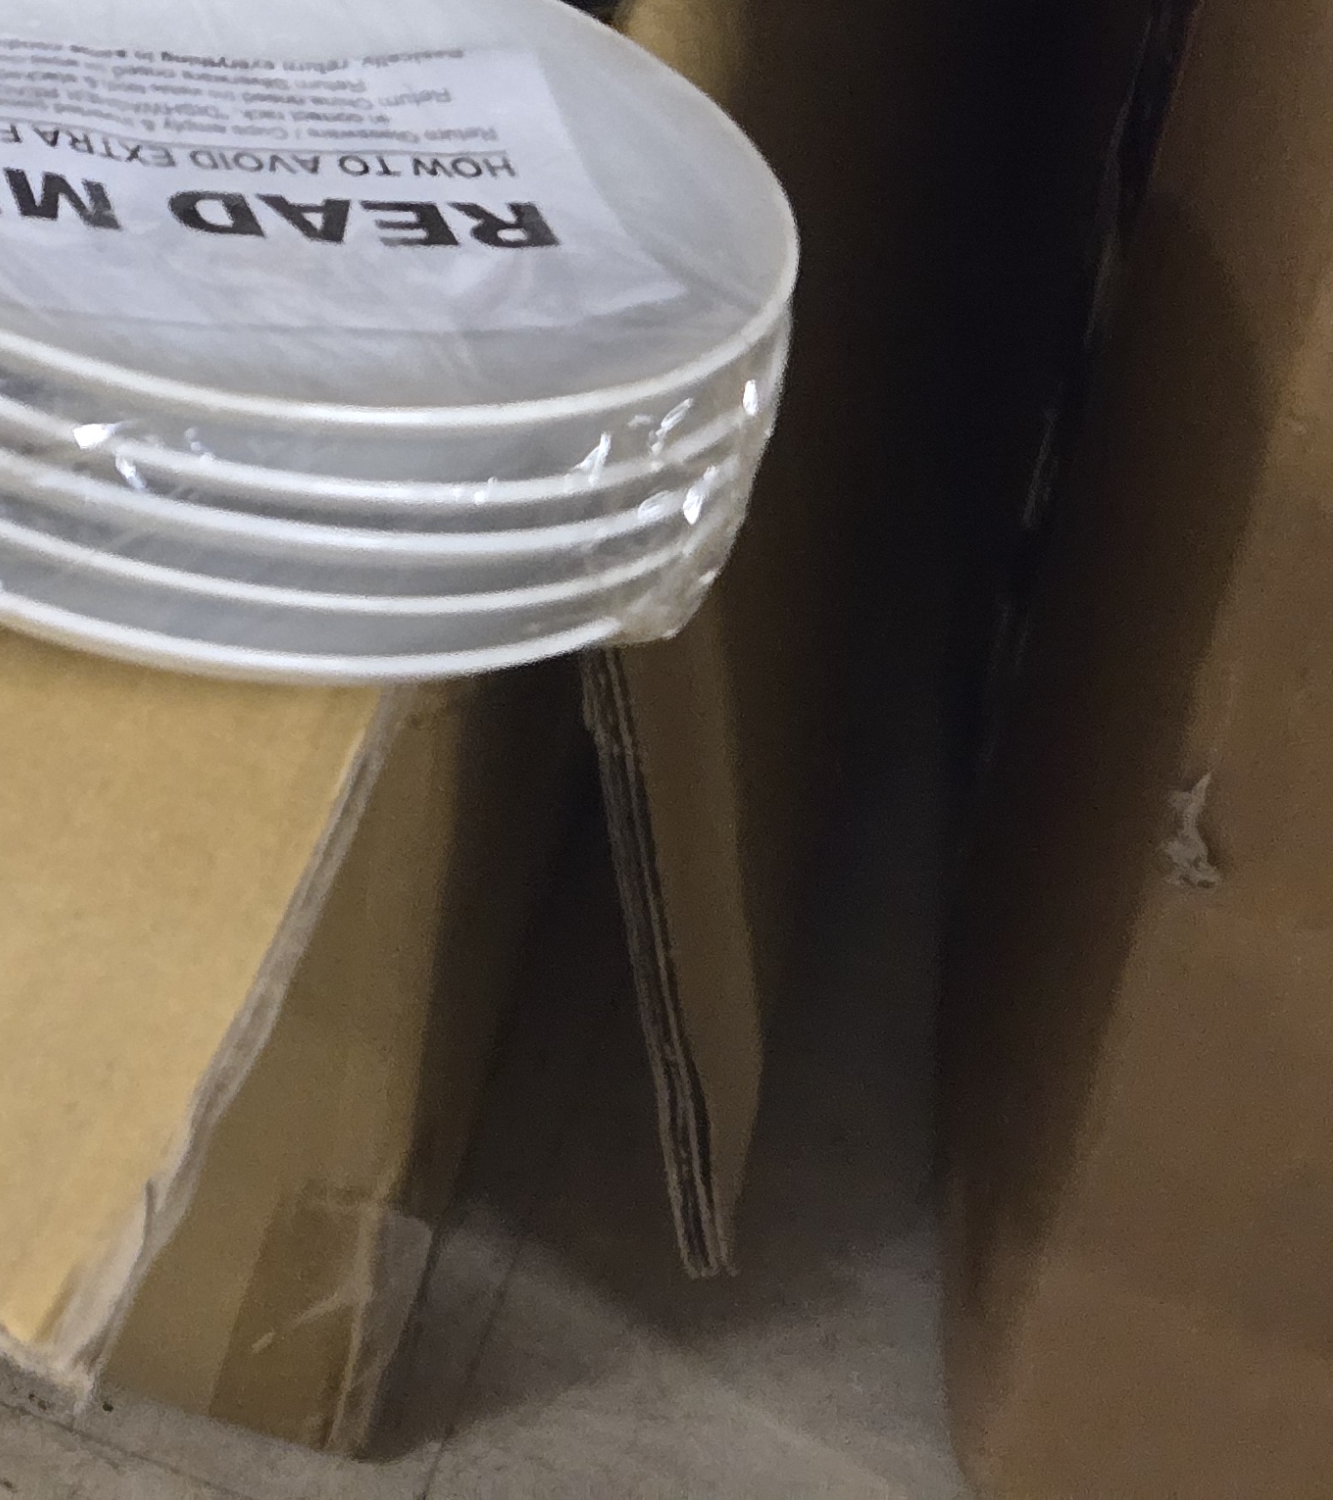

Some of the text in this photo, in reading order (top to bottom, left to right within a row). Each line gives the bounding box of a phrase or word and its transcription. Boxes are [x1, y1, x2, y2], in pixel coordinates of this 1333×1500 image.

[30, 123, 177, 168] EXTRA
[186, 148, 326, 175] AVOID
[334, 153, 402, 178] TO
[408, 157, 516, 178] HOW
[167, 188, 562, 251] READ
